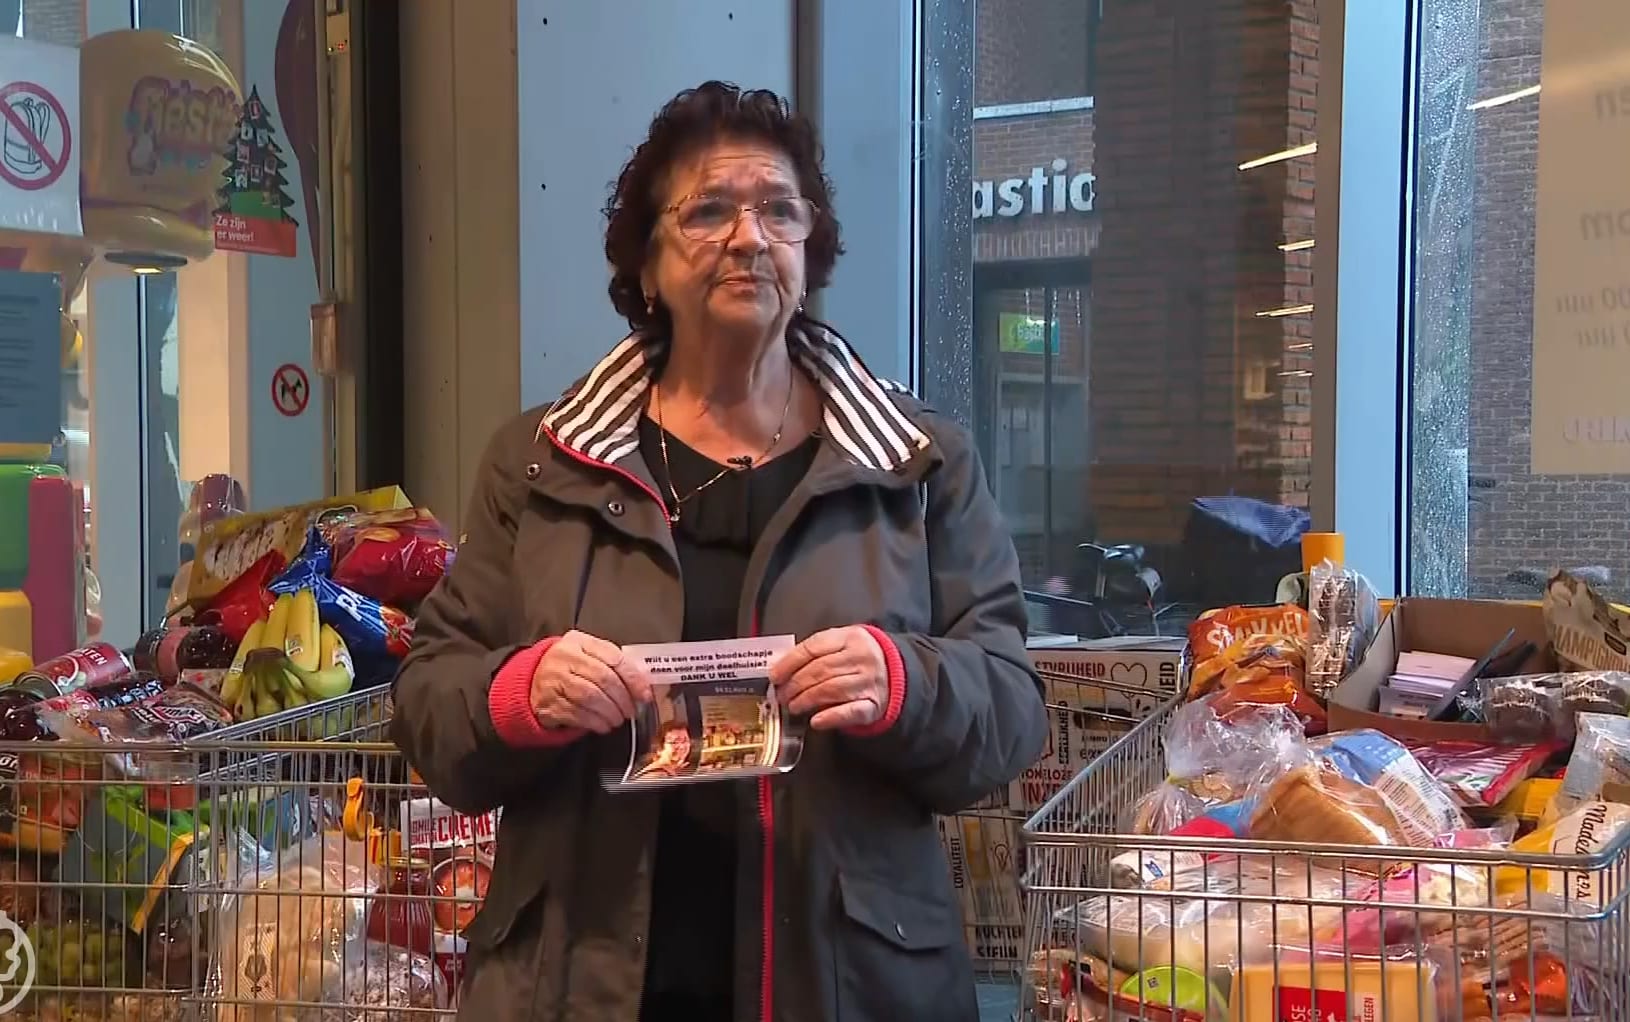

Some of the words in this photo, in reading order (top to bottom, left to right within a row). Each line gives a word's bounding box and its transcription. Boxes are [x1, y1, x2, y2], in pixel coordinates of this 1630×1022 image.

[690, 653, 713, 661] extra
[715, 650, 773, 660] boodschapje
[674, 665, 693, 673] voor
[695, 664, 715, 672] mijn
